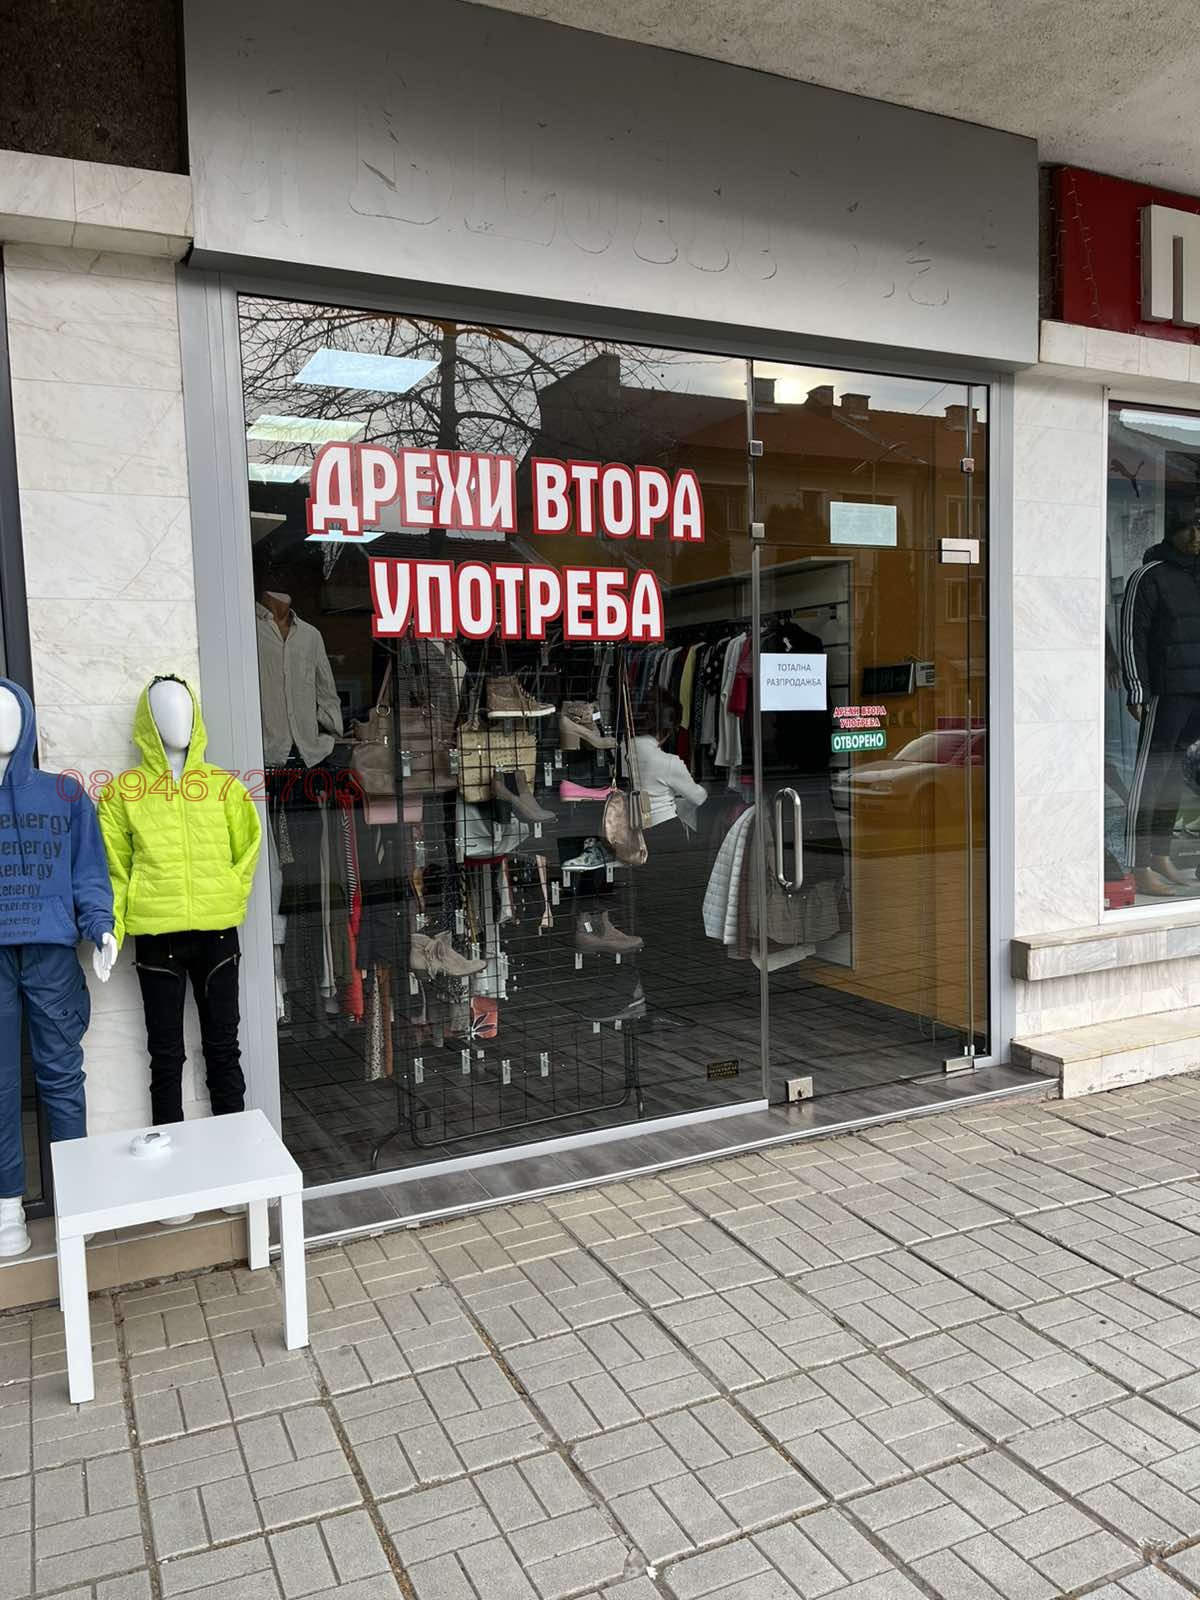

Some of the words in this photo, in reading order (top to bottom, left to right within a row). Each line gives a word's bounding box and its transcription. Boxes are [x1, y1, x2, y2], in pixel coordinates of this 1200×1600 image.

[309, 443, 516, 534] ДРЕХИ
[534, 459, 703, 540] ВТОРА
[371, 559, 663, 639] УПОТРЕБА
[777, 663, 812, 672] ТОТАЛНА
[767, 678, 822, 687] РАЗПРОДАЖБА
[833, 733, 884, 750] ОТВОРЕНО
